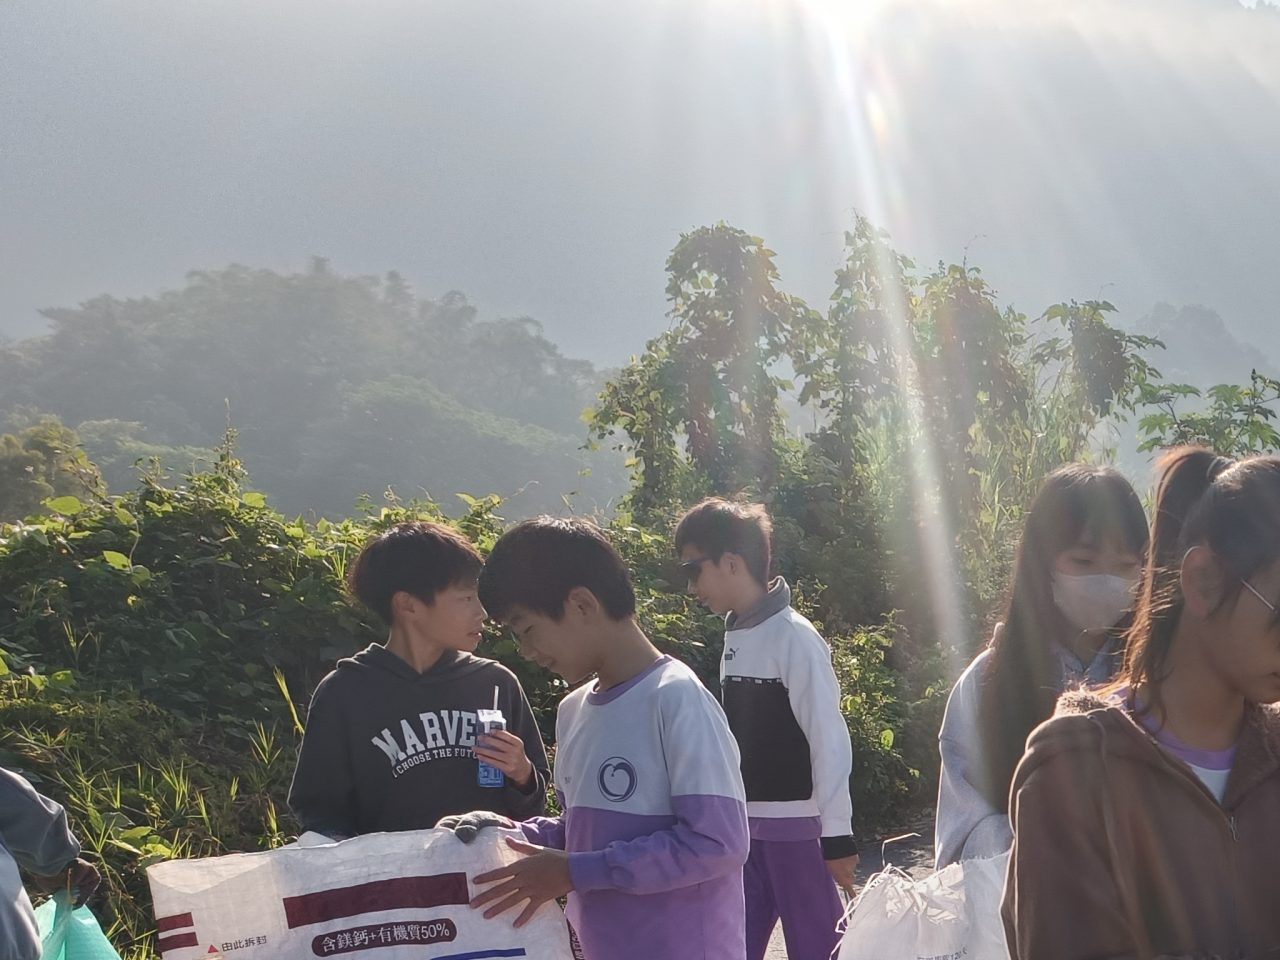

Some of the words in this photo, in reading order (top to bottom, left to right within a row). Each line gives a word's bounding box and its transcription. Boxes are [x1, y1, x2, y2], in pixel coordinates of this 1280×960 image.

[371, 709, 478, 768] MARVE
[396, 752, 431, 775] CHOOSE
[433, 748, 452, 759] THE
[222, 935, 267, 952] 由此拆封
[322, 923, 450, 953] 含鎂鈣+有機質50%
